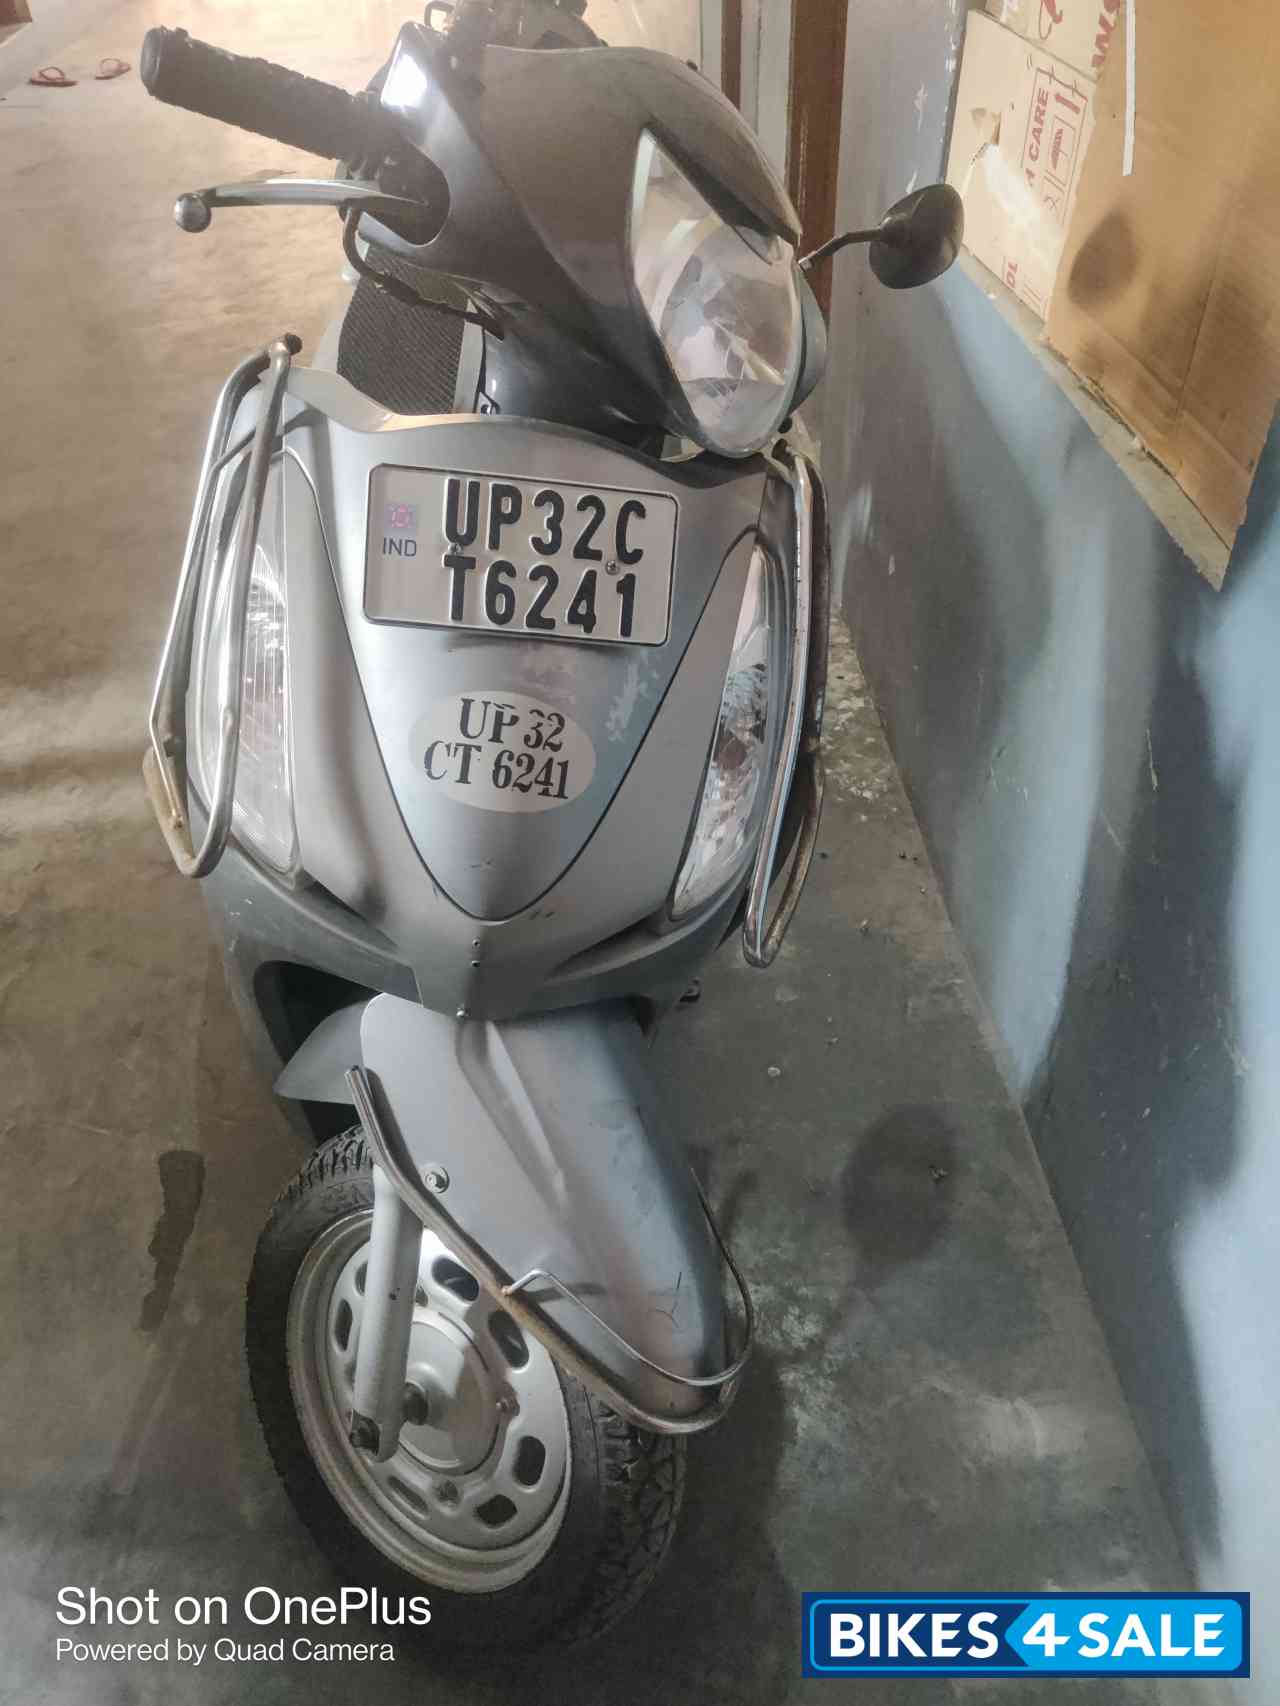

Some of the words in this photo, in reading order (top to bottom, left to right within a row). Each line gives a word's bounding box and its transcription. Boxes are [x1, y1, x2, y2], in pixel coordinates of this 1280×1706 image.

[1030, 87, 1049, 162] CARE
[382, 536, 417, 557] IND
[444, 478, 646, 565] UP32C
[443, 554, 637, 638] T6241
[460, 698, 520, 744] UP
[523, 708, 567, 752] 32
[424, 740, 482, 785] CT
[491, 749, 569, 800] 6241
